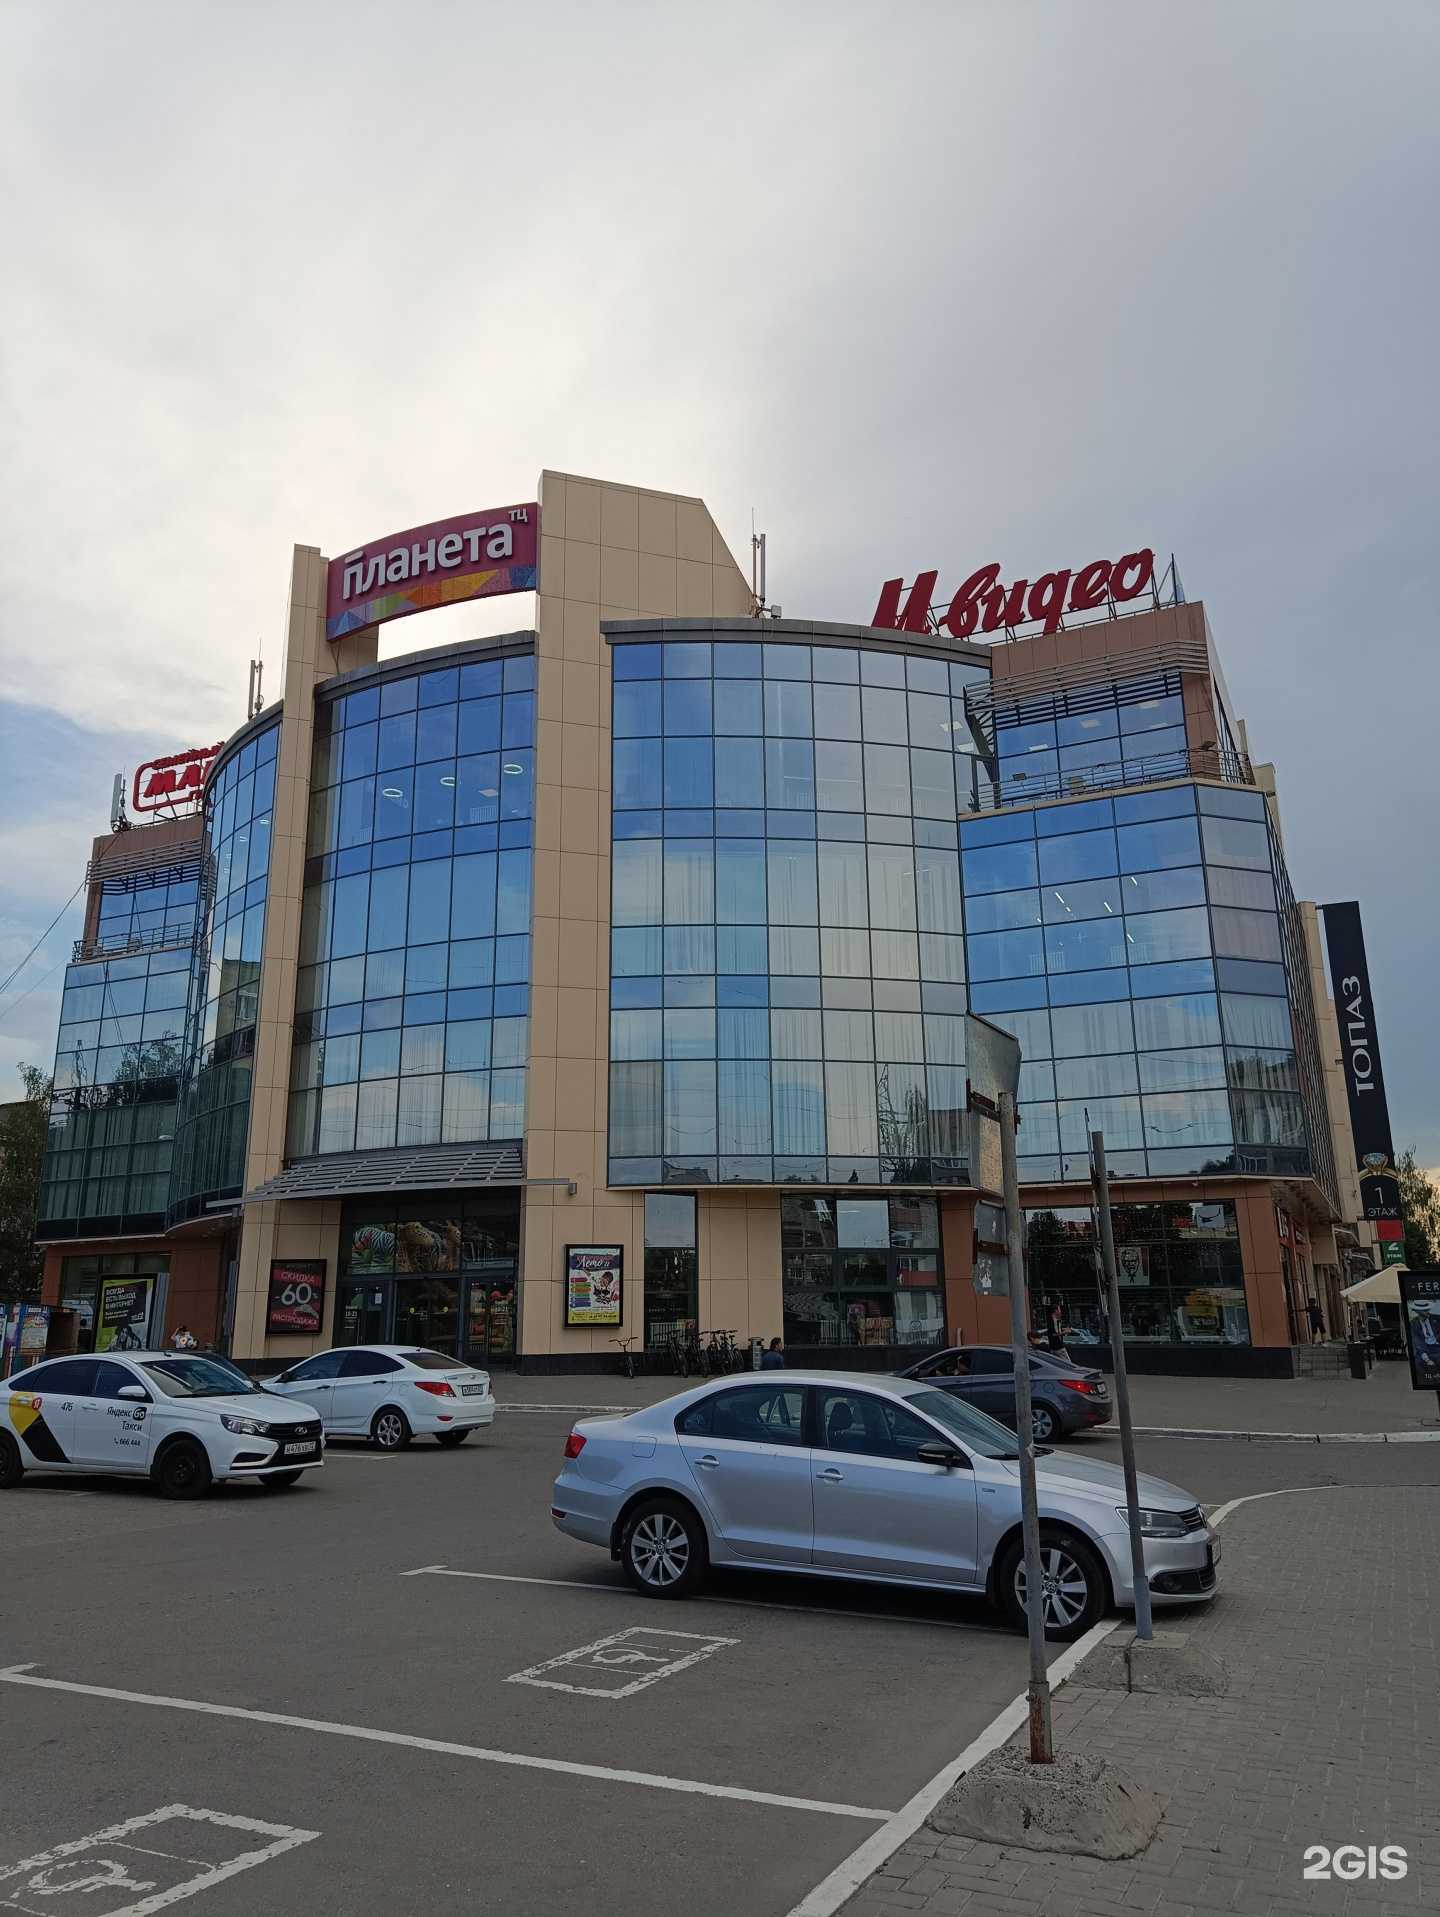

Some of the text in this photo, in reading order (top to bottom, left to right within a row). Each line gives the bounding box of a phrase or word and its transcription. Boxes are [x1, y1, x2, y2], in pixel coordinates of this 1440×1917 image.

[508, 508, 529, 523] ТЦ
[1341, 975, 1375, 1097] ТОПАЗ
[1374, 1186, 1384, 1206] 1
[1367, 1206, 1399, 1217] ЭТАЖ
[280, 1271, 316, 1284] СКИДКА
[106, 1406, 133, 1418] Яндекс
[121, 1420, 142, 1432] Такси
